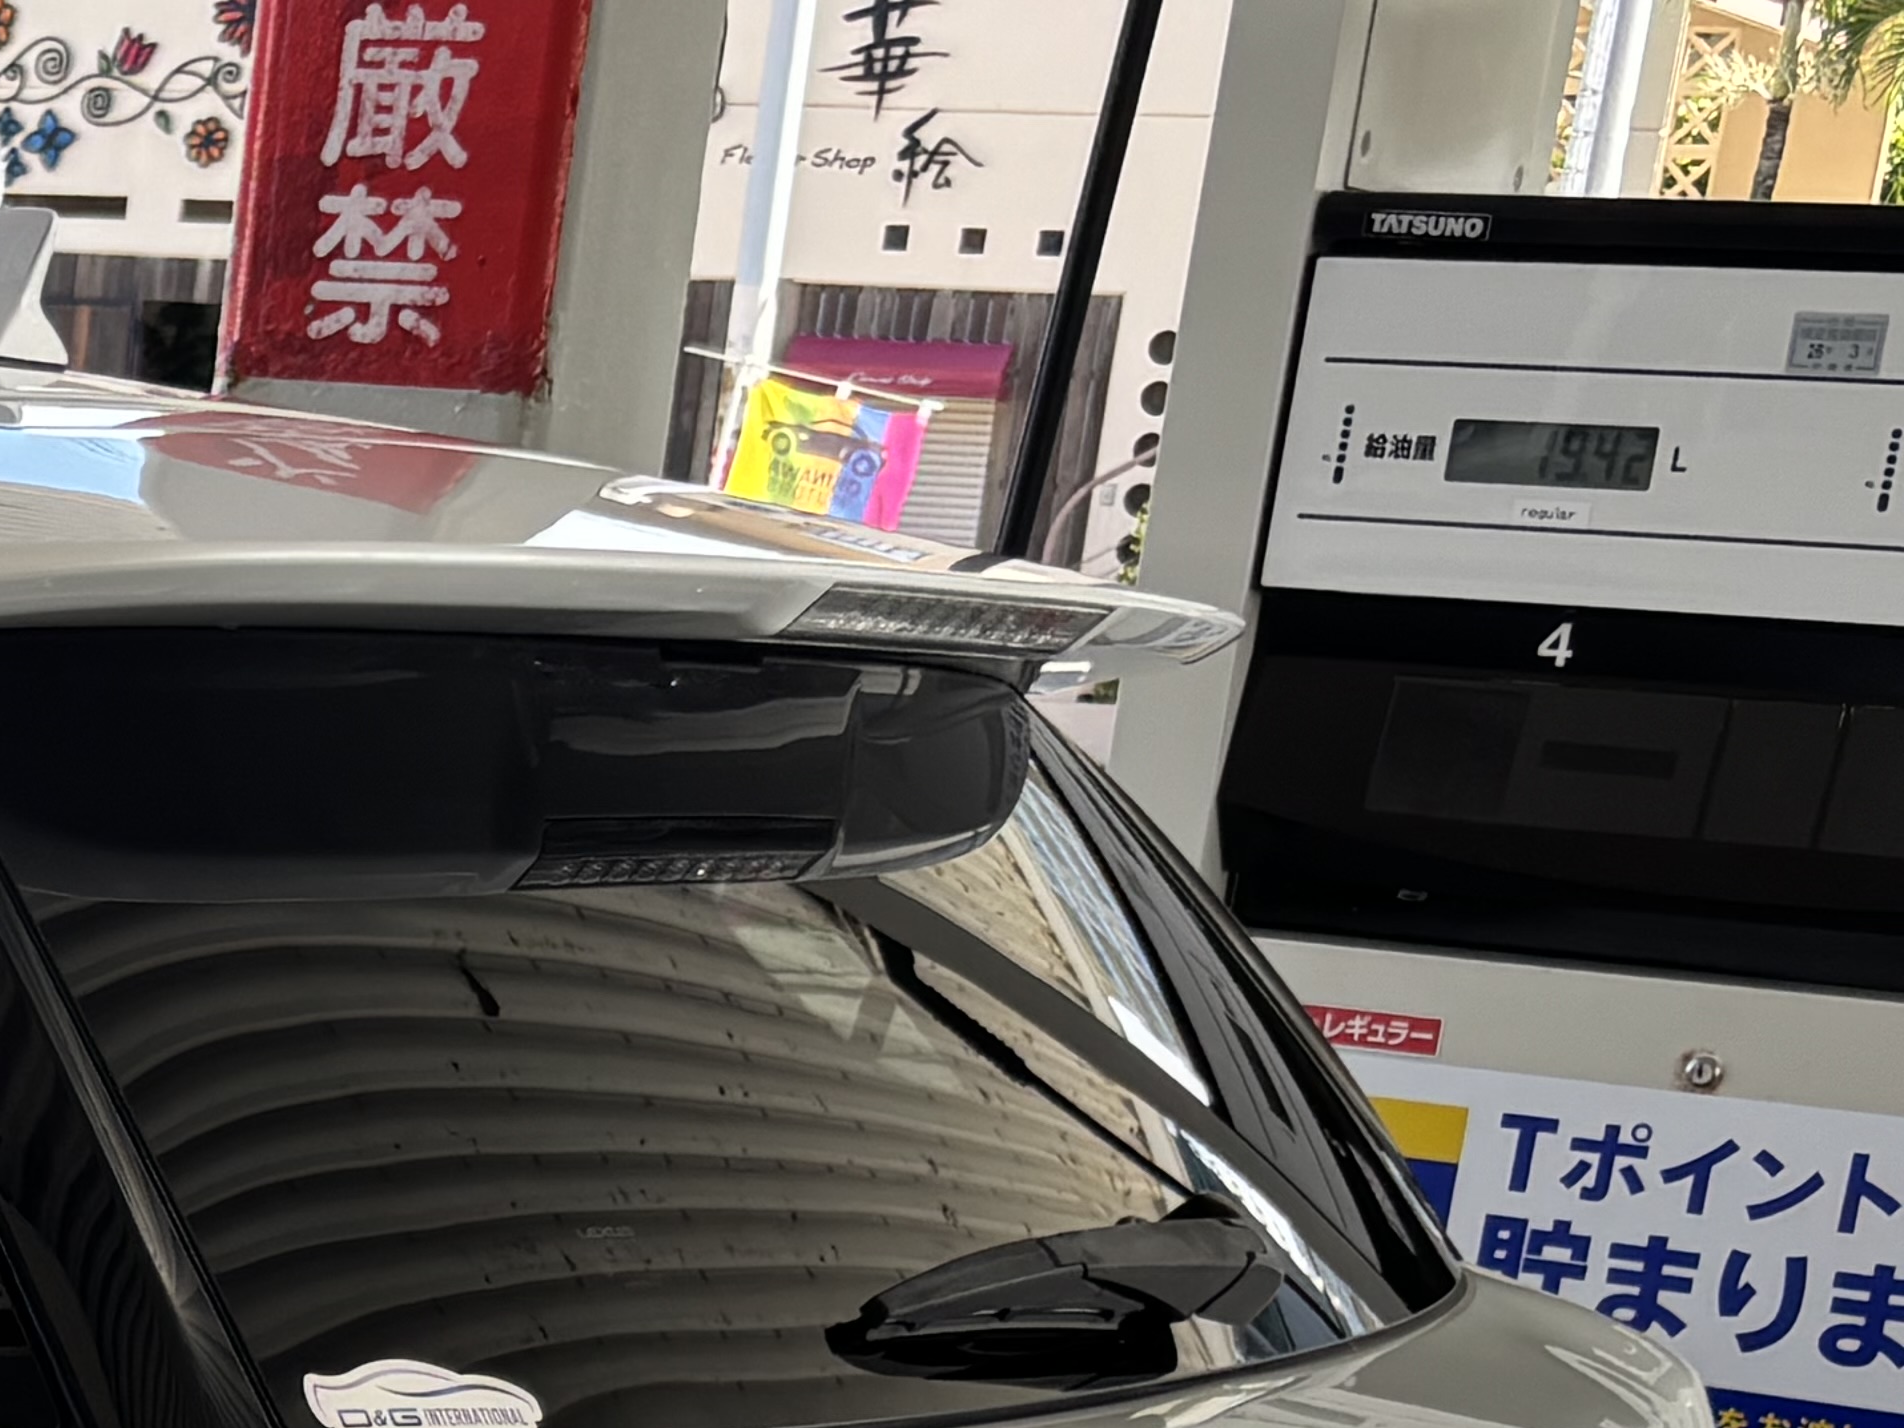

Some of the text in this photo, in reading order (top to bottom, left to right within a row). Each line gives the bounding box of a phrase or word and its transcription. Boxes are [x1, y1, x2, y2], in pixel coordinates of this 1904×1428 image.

[306, 2, 485, 346] 厳禁
[811, 148, 876, 174] Shop
[1371, 212, 1484, 238] TATSUNO
[1364, 433, 1437, 461] 給油量
[1670, 446, 1686, 473] L
[1521, 505, 1577, 522] regular
[1537, 622, 1574, 668] 4
[1313, 1012, 1434, 1046] レギュラー
[1500, 1111, 1903, 1236] Tポイント
[1476, 1212, 1904, 1371] 貯まりま
[423, 1408, 529, 1427] INTERNATIONAL
